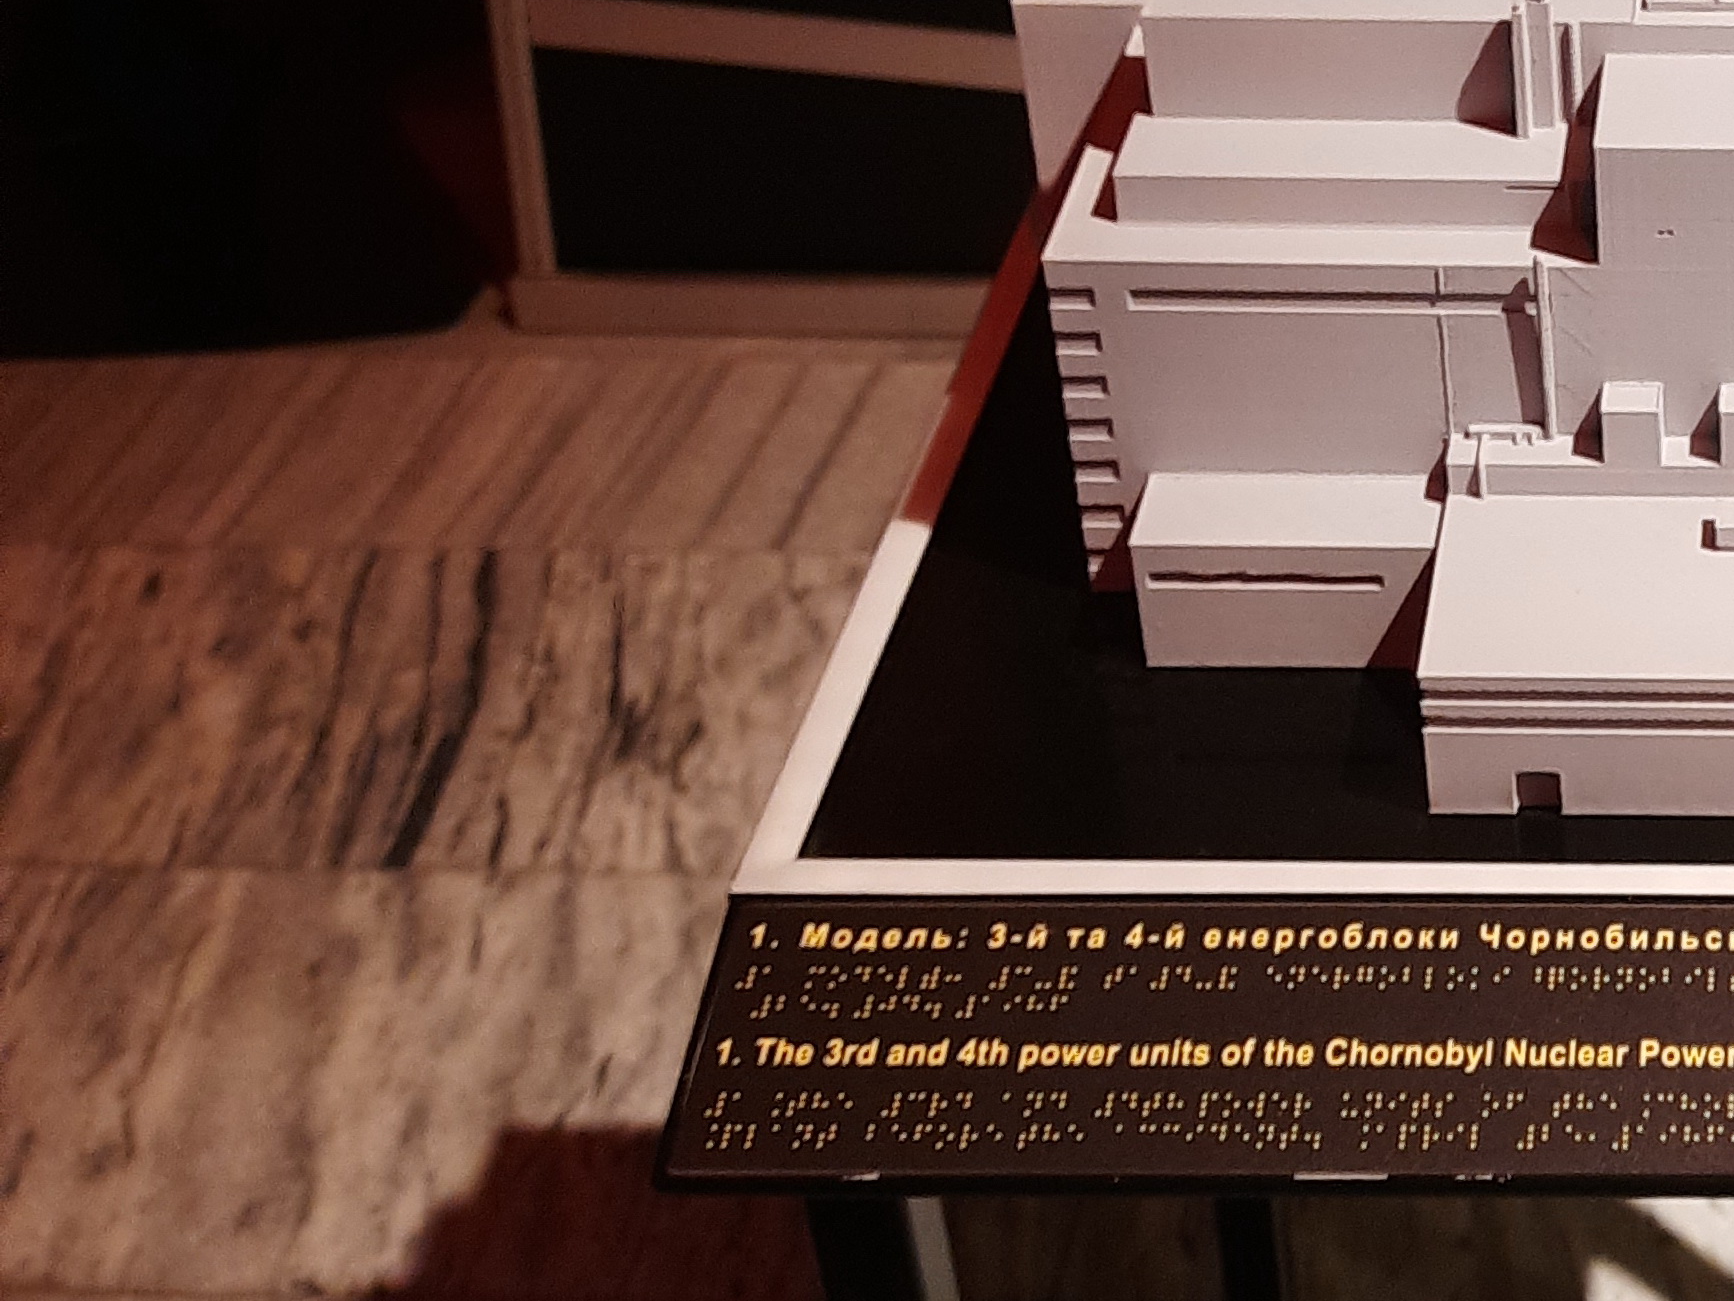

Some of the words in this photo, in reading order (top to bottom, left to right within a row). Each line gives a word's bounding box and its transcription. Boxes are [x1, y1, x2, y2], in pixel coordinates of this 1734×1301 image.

[750, 921, 779, 950] 1.
[799, 921, 969, 954] Модель:
[987, 921, 1049, 950] 3-й
[1067, 927, 1107, 950] та
[1124, 921, 1185, 950] 4-й
[1203, 920, 1460, 956] енергоблоки
[717, 1037, 741, 1067] 1.
[756, 1037, 815, 1067] The
[822, 1037, 881, 1067] 3rd
[885, 1037, 951, 1067] and
[956, 1037, 1010, 1067] 4th
[1017, 1043, 1122, 1074] power
[1129, 1038, 1211, 1068] units
[1220, 1037, 1258, 1067] of
[1263, 1037, 1316, 1068] the
[1325, 1037, 1495, 1074] Chornobyl
[1504, 1038, 1630, 1069] Nuclear
